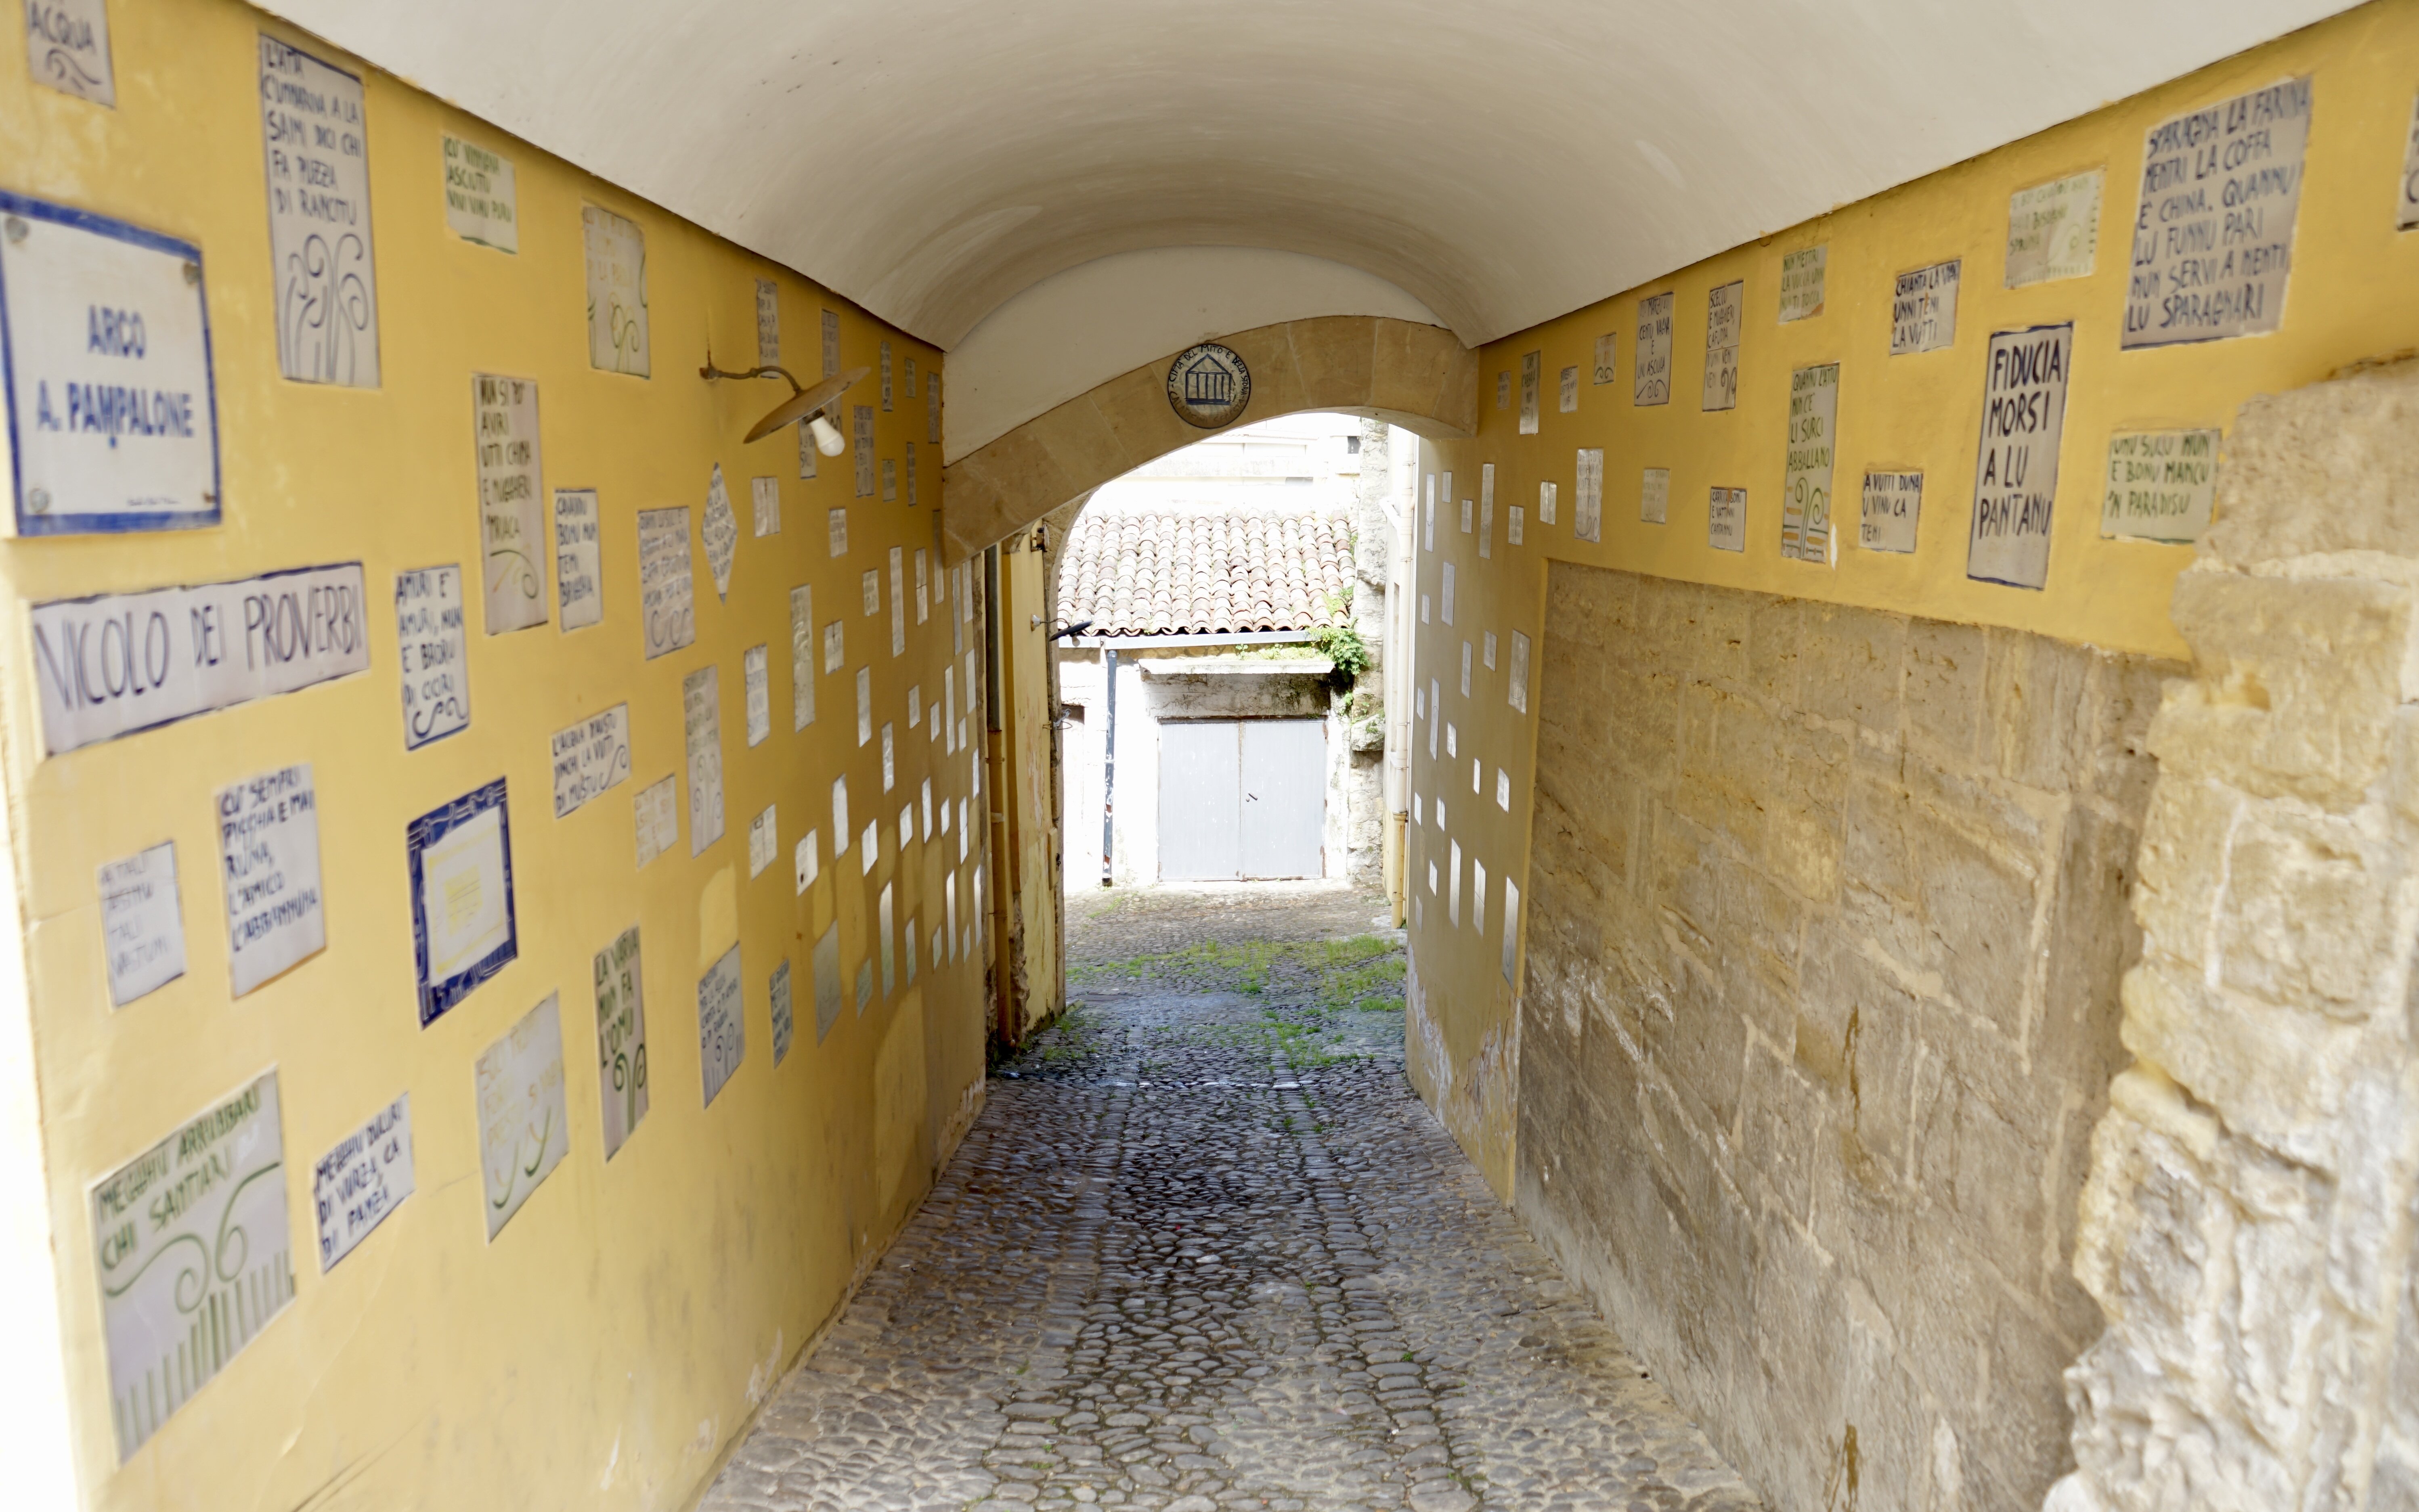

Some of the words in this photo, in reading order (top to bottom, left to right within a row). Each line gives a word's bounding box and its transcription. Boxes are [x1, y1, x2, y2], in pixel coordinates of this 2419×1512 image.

[2147, 110, 2220, 159] SPARAGNA
[2228, 96, 2247, 134] LA
[2196, 144, 2218, 180] LA
[2223, 128, 2272, 172] COFFA
[275, 188, 293, 215] DI
[2221, 165, 2296, 208] QUANNU
[2134, 230, 2159, 267] LU
[2224, 207, 2264, 246] PARI
[1782, 275, 1790, 292] LA
[1930, 268, 1939, 289] LA
[2168, 257, 2218, 294] SERVI
[2220, 250, 2234, 279] A
[1709, 312, 1713, 330] E
[2127, 304, 2151, 333] LU
[2159, 282, 2265, 329] SPARAGNARI
[88, 304, 146, 359] ARCO
[1652, 340, 1654, 355] E
[1893, 325, 1906, 348] LA
[1183, 350, 1198, 360] DEL
[1201, 345, 1223, 354] MITO
[1232, 355, 1245, 375] DELLA
[1993, 339, 2061, 392] FIDUCIA
[38, 379, 61, 432] A.
[66, 381, 195, 438] PAMPALONE
[1989, 390, 2051, 438] MORSI
[1791, 422, 1798, 444] LI
[1801, 416, 1824, 442] SURCI
[2141, 435, 2175, 458] SULU
[2181, 434, 2210, 457] NUN
[1863, 474, 1871, 492] A
[1874, 473, 1895, 492] VUTTI
[1984, 448, 1995, 486] A
[2004, 445, 2029, 488] LU
[2126, 461, 2160, 483] BONU
[1863, 496, 1870, 517] U
[1894, 498, 1906, 518] CA
[1979, 493, 2052, 540] PANTANU
[2127, 490, 2191, 519] PARADISU
[33, 609, 170, 713] VICOLO
[190, 603, 227, 669] DEI
[244, 584, 361, 672] PROVERBI
[249, 766, 301, 808] SEMPRI
[278, 800, 288, 823] E
[289, 788, 314, 816] MAI
[319, 1193, 334, 1226] DI
[383, 1136, 400, 1165] CA
[102, 1219, 138, 1271] CHI
[322, 1227, 339, 1262] DI
